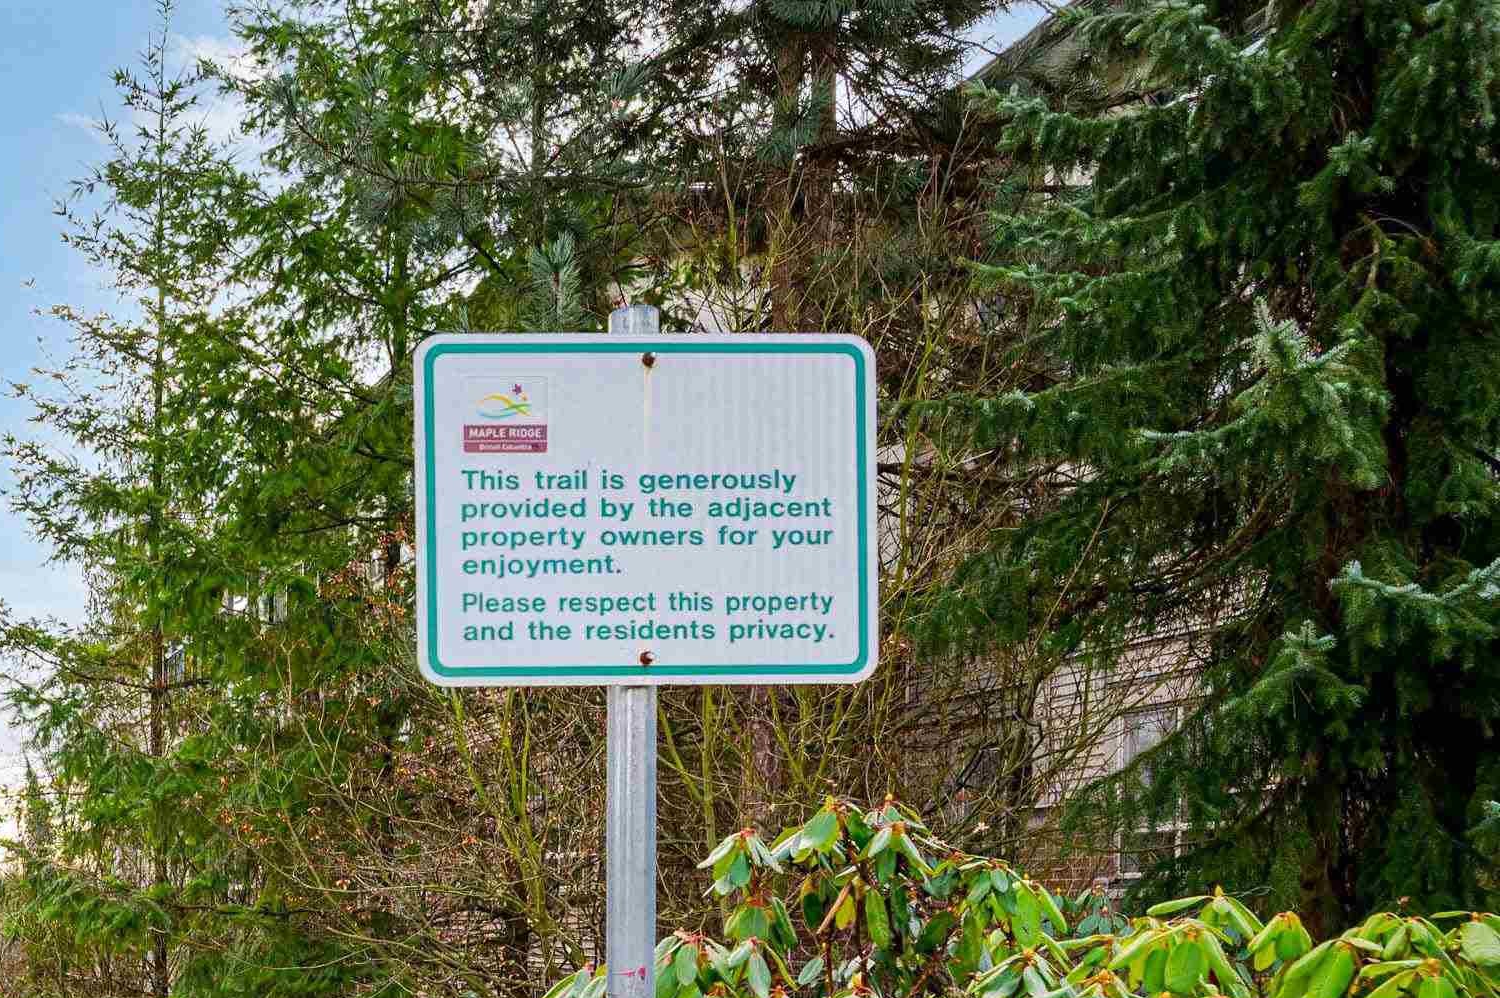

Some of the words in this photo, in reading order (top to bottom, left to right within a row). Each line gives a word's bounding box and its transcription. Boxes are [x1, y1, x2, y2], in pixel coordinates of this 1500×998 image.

[469, 428, 506, 438] MAPLE
[508, 428, 542, 438] RIDGE
[461, 470, 519, 490] This
[534, 470, 587, 490] trail
[602, 469, 624, 490] is
[639, 469, 796, 495] generously
[461, 498, 586, 522] provided
[601, 497, 634, 522] by
[648, 498, 693, 518] the
[708, 497, 832, 521] adjacent
[462, 527, 586, 551] property
[600, 528, 704, 546] owners
[718, 525, 758, 545] for
[772, 530, 833, 550] your
[462, 555, 621, 578] enjoyment.
[462, 592, 546, 613] Please
[559, 592, 656, 616] respect
[668, 592, 713, 612] this
[726, 592, 833, 615] property
[463, 621, 513, 641] and
[528, 620, 572, 640] the
[585, 620, 715, 640] residents
[730, 619, 834, 643] privacy.
